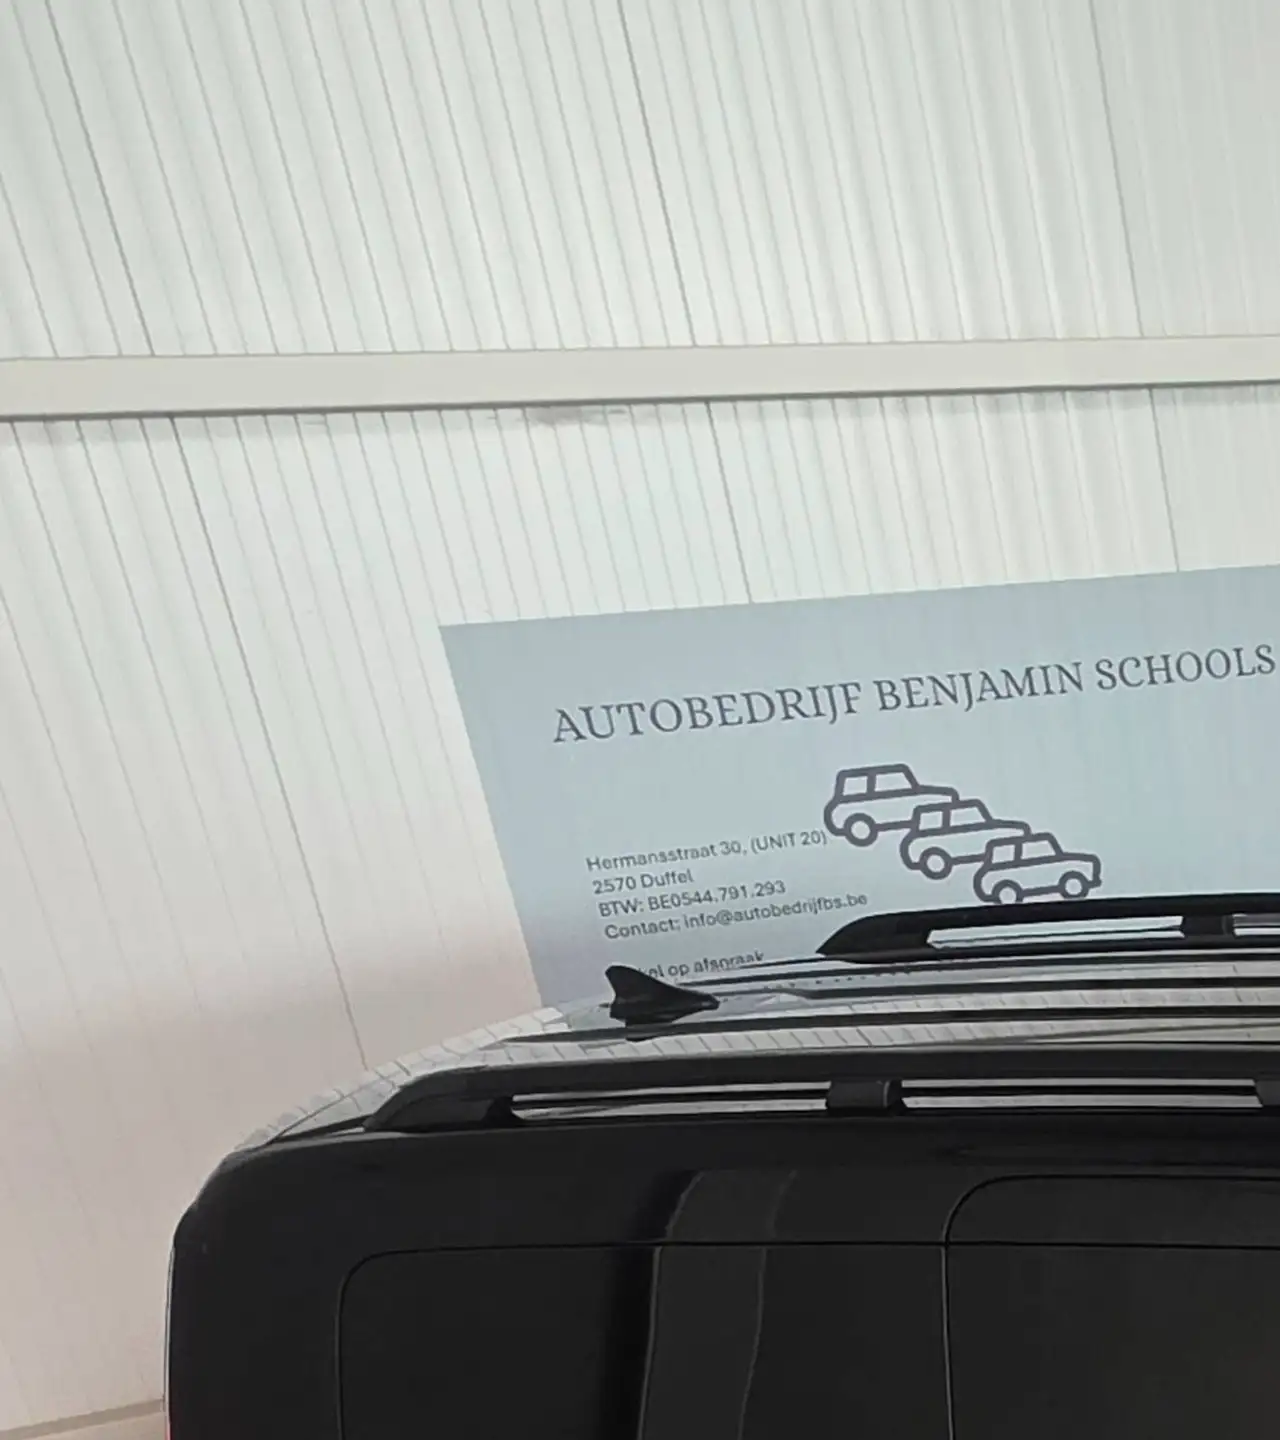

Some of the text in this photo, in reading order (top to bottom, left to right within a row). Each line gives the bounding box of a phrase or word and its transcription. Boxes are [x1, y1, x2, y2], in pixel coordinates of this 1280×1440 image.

[553, 644, 1276, 743] AUTOBEDRIJF BENJAMIN SCHOOLS
[586, 829, 828, 872] Hermansstraat 30, (UNIT 20)
[592, 869, 694, 896] 2570 Duffel
[598, 880, 786, 918] BTW: BE0544.791.293
[604, 893, 868, 940] Contact: info@autobedrijfbs.be
[667, 963, 690, 978] op
